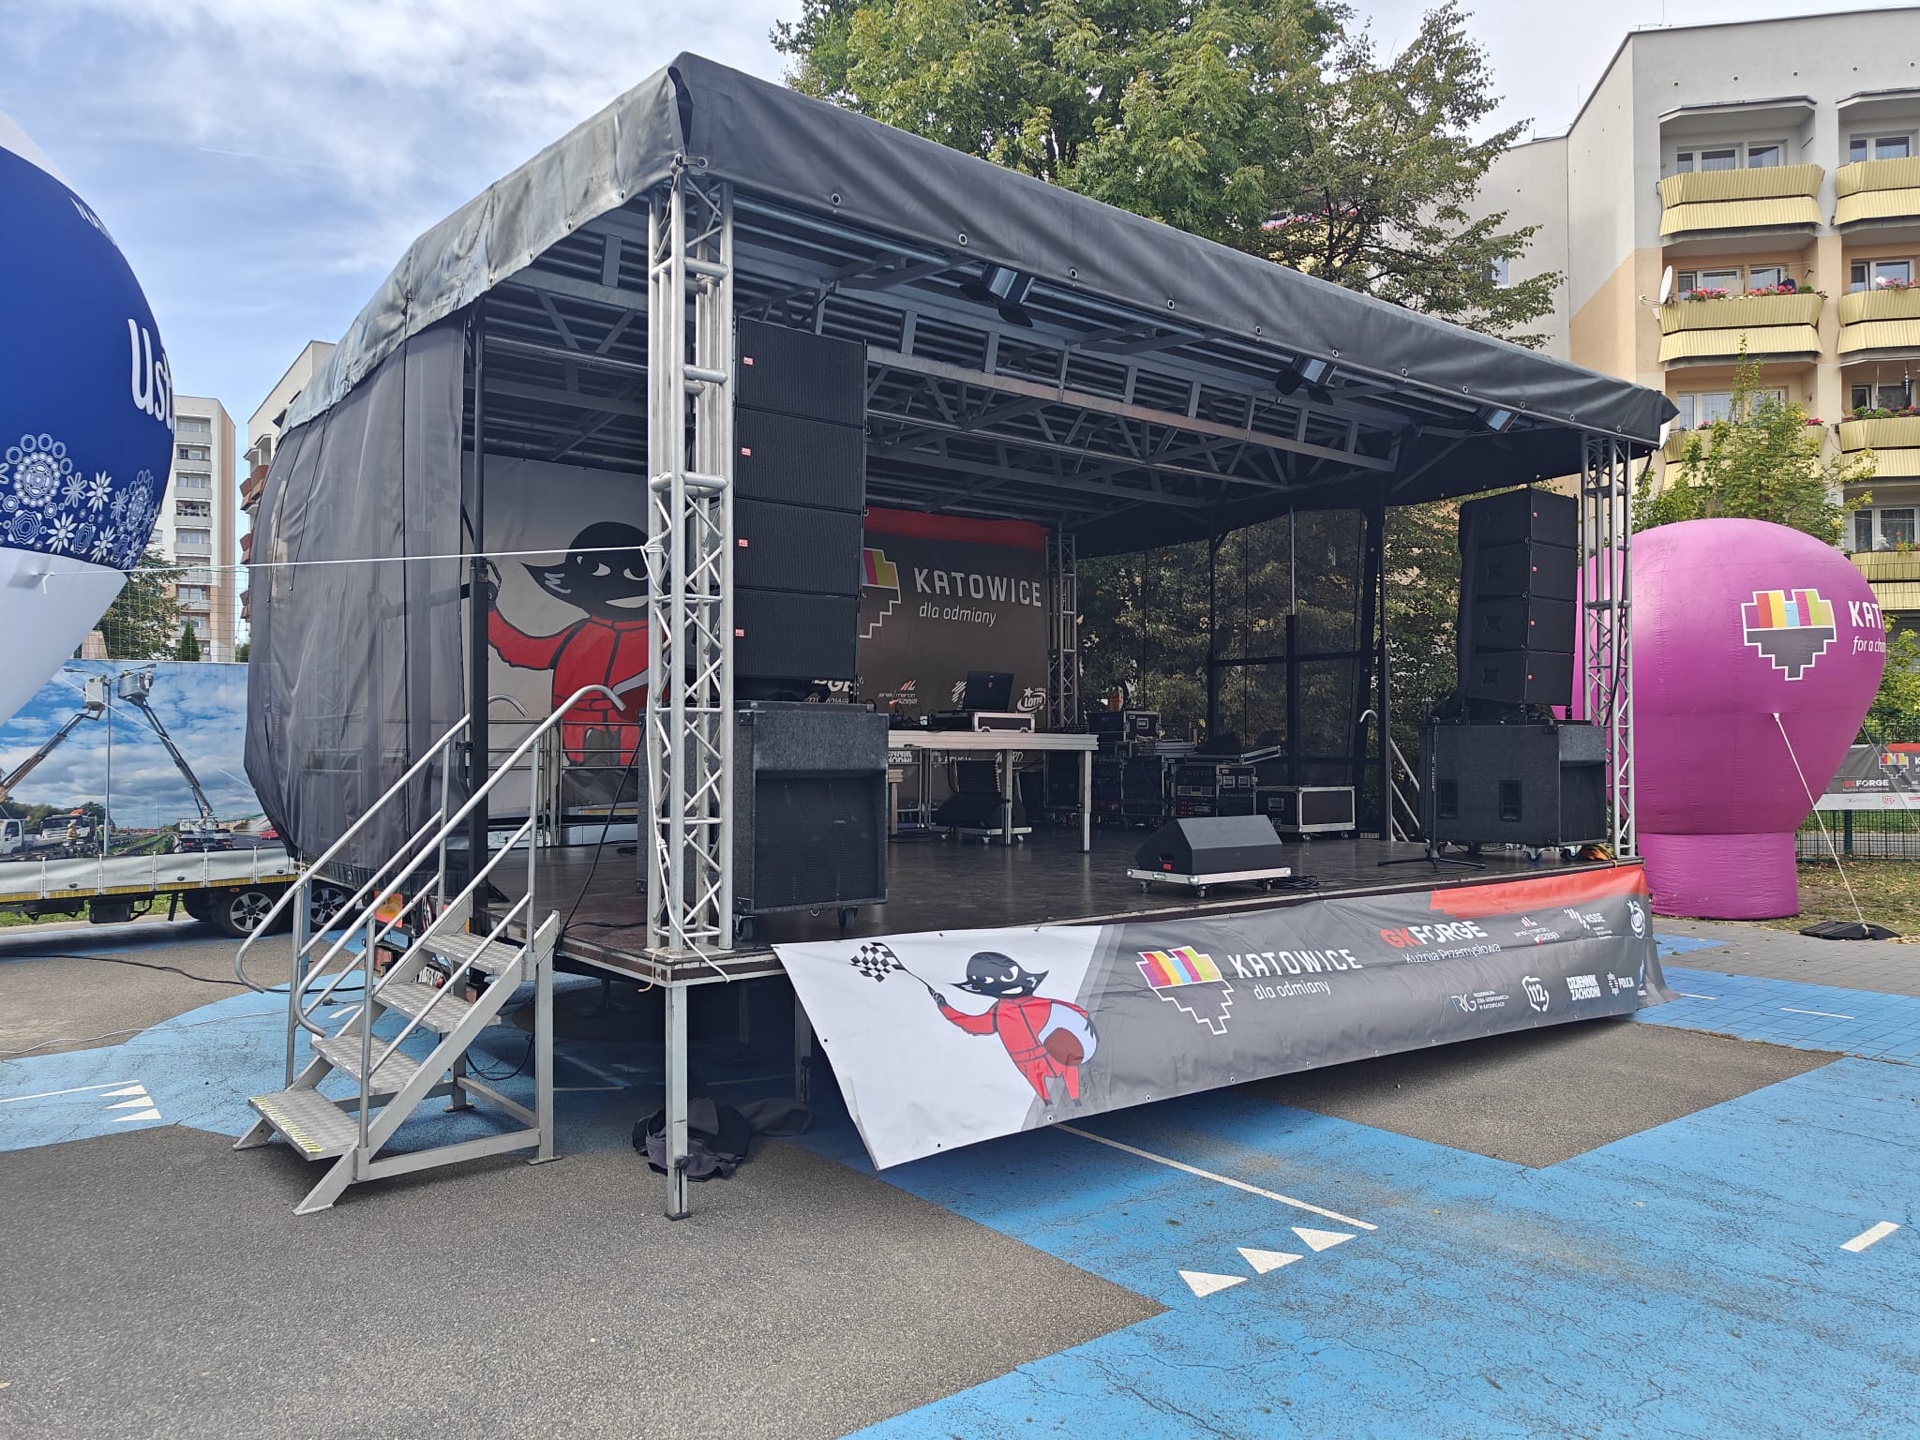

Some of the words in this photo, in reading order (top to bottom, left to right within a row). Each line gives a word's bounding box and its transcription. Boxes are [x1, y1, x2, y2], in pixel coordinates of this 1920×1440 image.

[914, 567, 1042, 607] KATOWICE
[919, 602, 938, 619] dla
[943, 605, 997, 627] odmiany
[1848, 600, 1883, 630] KAT
[1852, 635, 1867, 655] for
[1380, 921, 1489, 948] GKFORGE
[1228, 949, 1363, 979] KATOWICE
[1402, 950, 1441, 964] Kuźnia
[1254, 983, 1276, 1001] dla
[1277, 979, 1331, 997] odmiany
[1527, 983, 1546, 1002] 112
[1566, 974, 1599, 989] DZIENNIK
[1570, 985, 1601, 1001] ZACHODNI
